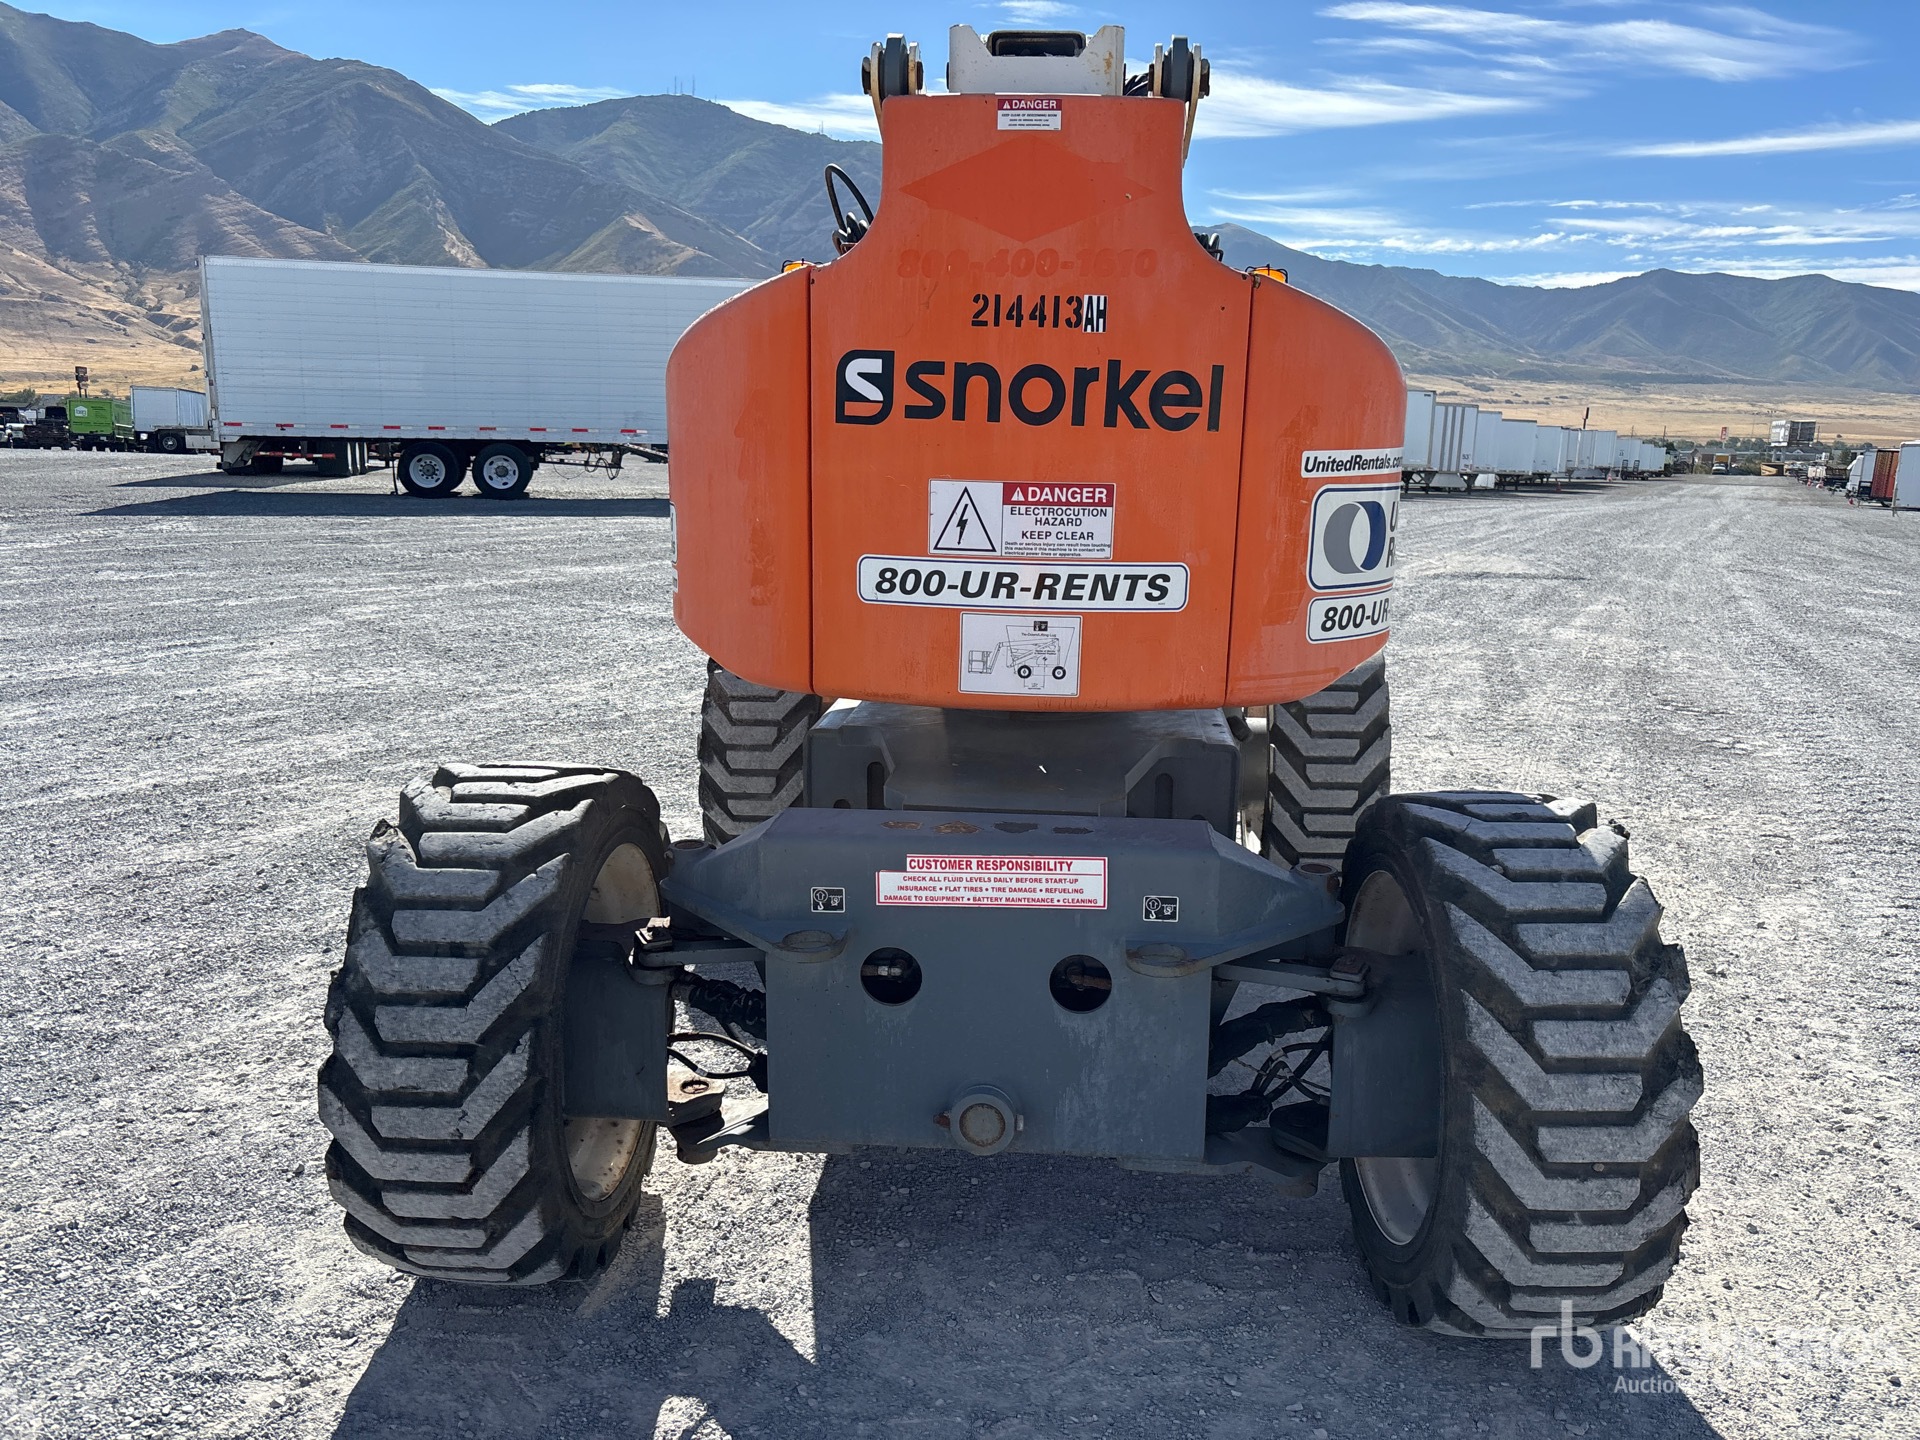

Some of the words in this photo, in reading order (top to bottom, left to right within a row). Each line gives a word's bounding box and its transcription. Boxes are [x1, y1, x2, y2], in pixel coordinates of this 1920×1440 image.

[1012, 100, 1057, 109] DANGER
[904, 359, 1224, 432] snorkel
[1028, 486, 1107, 503] DANGER
[1010, 506, 1107, 517] ELECTROCUTION
[1034, 517, 1082, 527] HAZARD
[1021, 530, 1052, 540] KEEP
[1055, 531, 1094, 541] CLEAR
[874, 567, 1171, 602] 800-UR-RENTS
[908, 858, 973, 871] CUSTOMER
[976, 859, 1073, 872] RESPONSIBILITY
